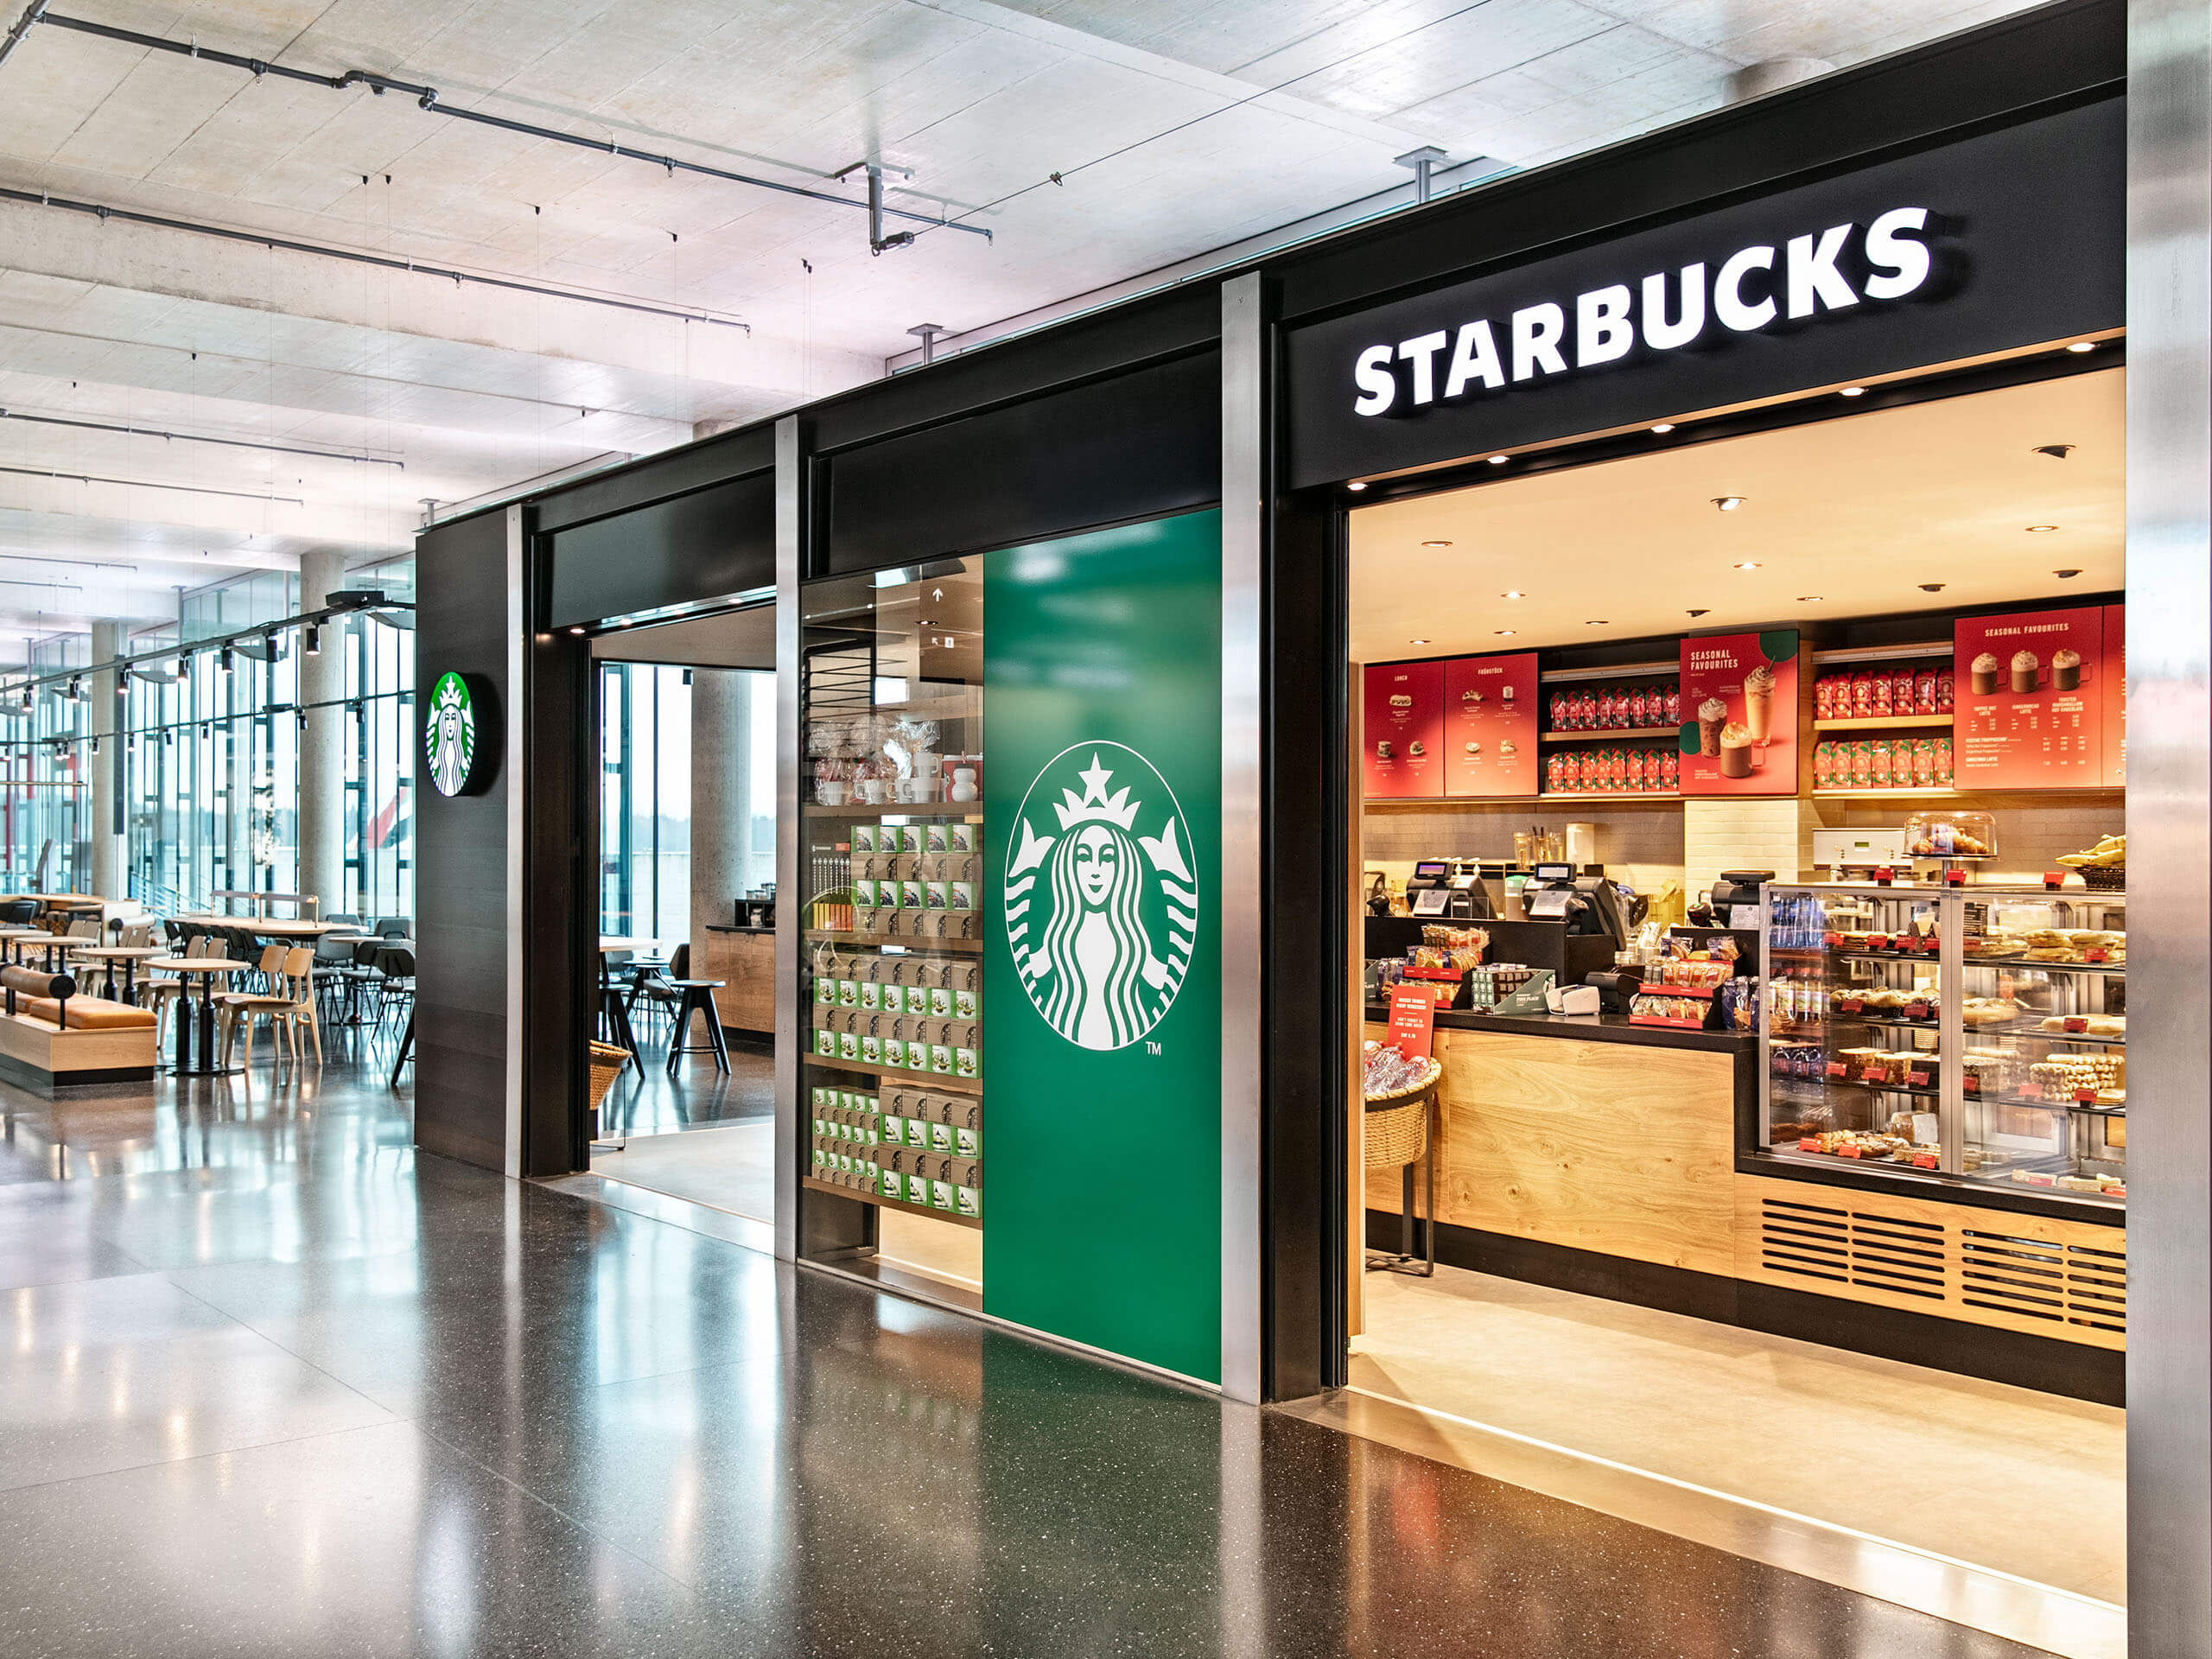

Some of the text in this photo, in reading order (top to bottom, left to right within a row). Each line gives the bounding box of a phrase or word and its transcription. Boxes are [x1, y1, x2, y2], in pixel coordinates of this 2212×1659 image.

[1354, 207, 1933, 418] STARBUCKS
[1985, 623, 2069, 637] SEASONAL FAVOURITES
[1690, 650, 1731, 661] SEASONAL
[1690, 659, 1738, 671] FAVOURITES
[1145, 1041, 1161, 1056] TM
